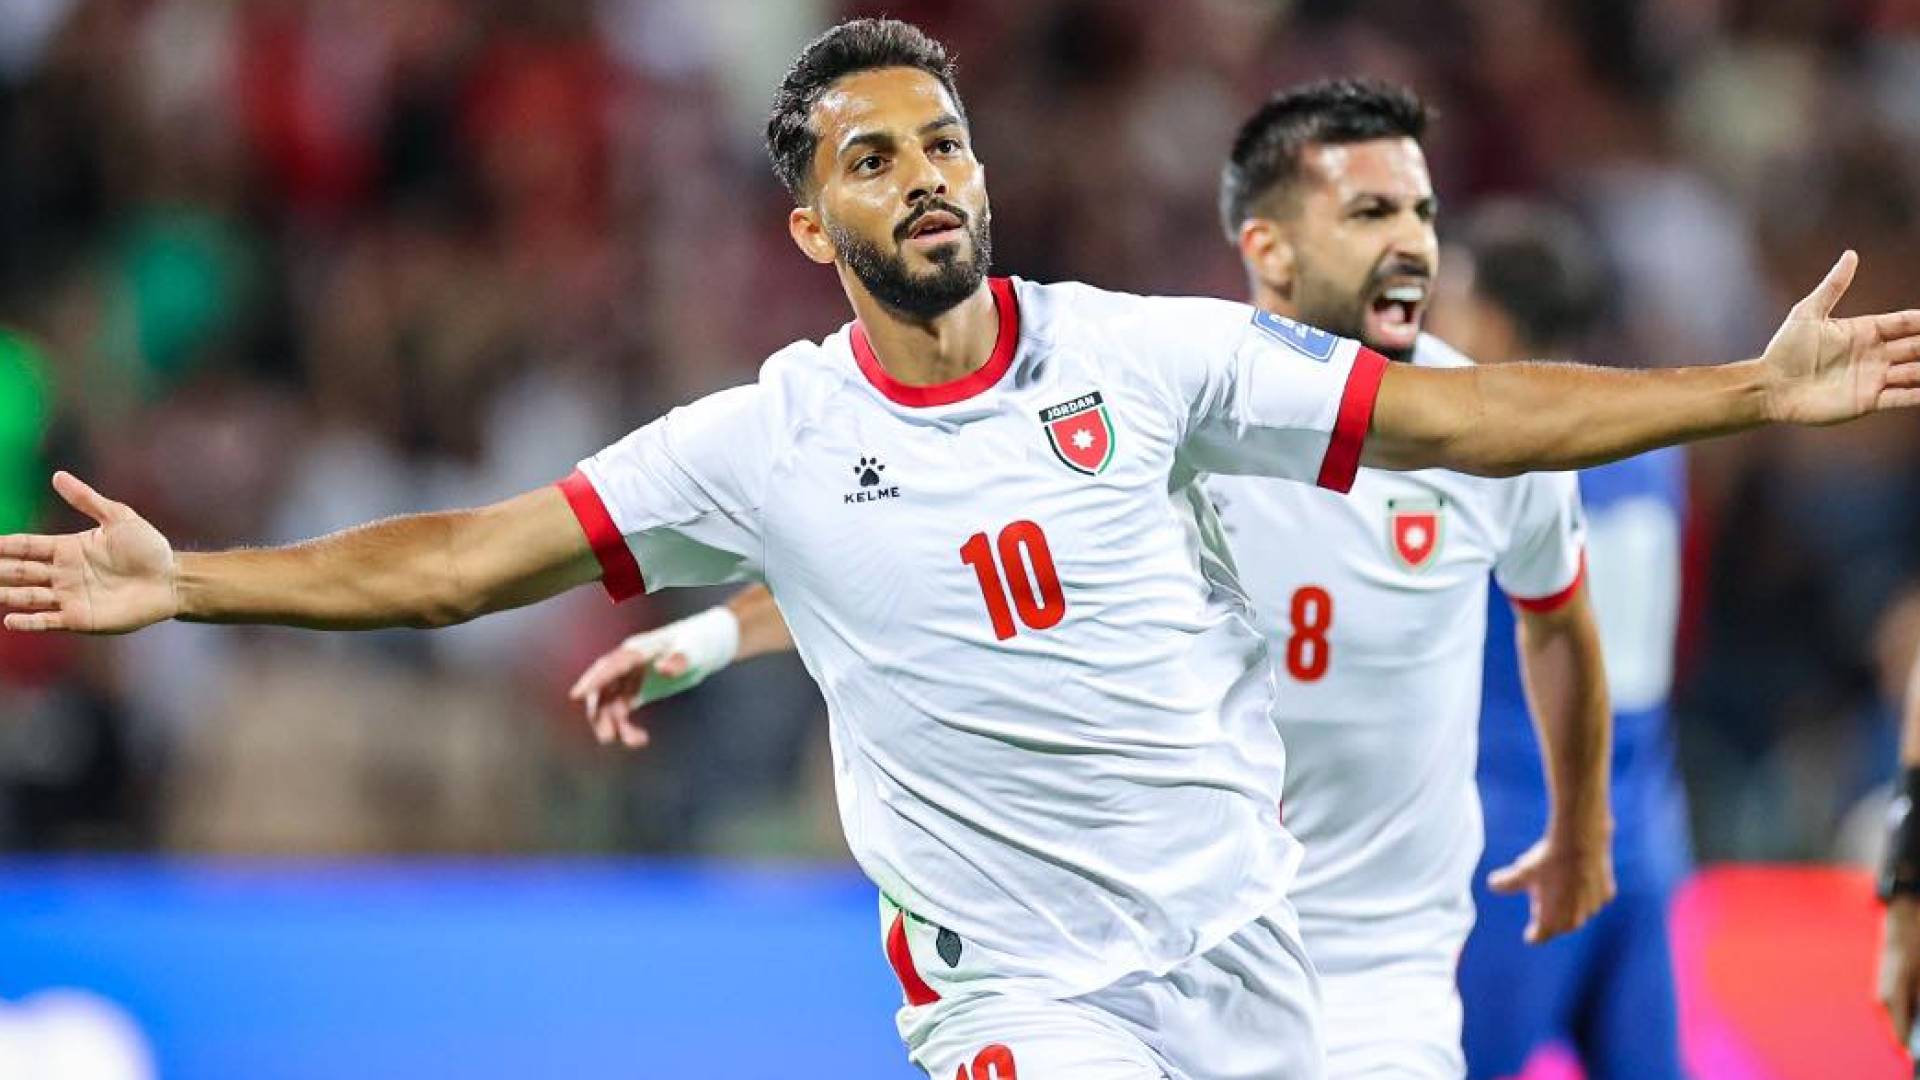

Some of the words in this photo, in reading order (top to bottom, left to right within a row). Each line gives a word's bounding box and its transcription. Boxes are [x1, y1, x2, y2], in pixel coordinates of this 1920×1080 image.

[1047, 395, 1095, 421] JORDAN
[843, 486, 900, 504] KELME
[959, 520, 1066, 641] 10
[1286, 585, 1332, 683] 8
